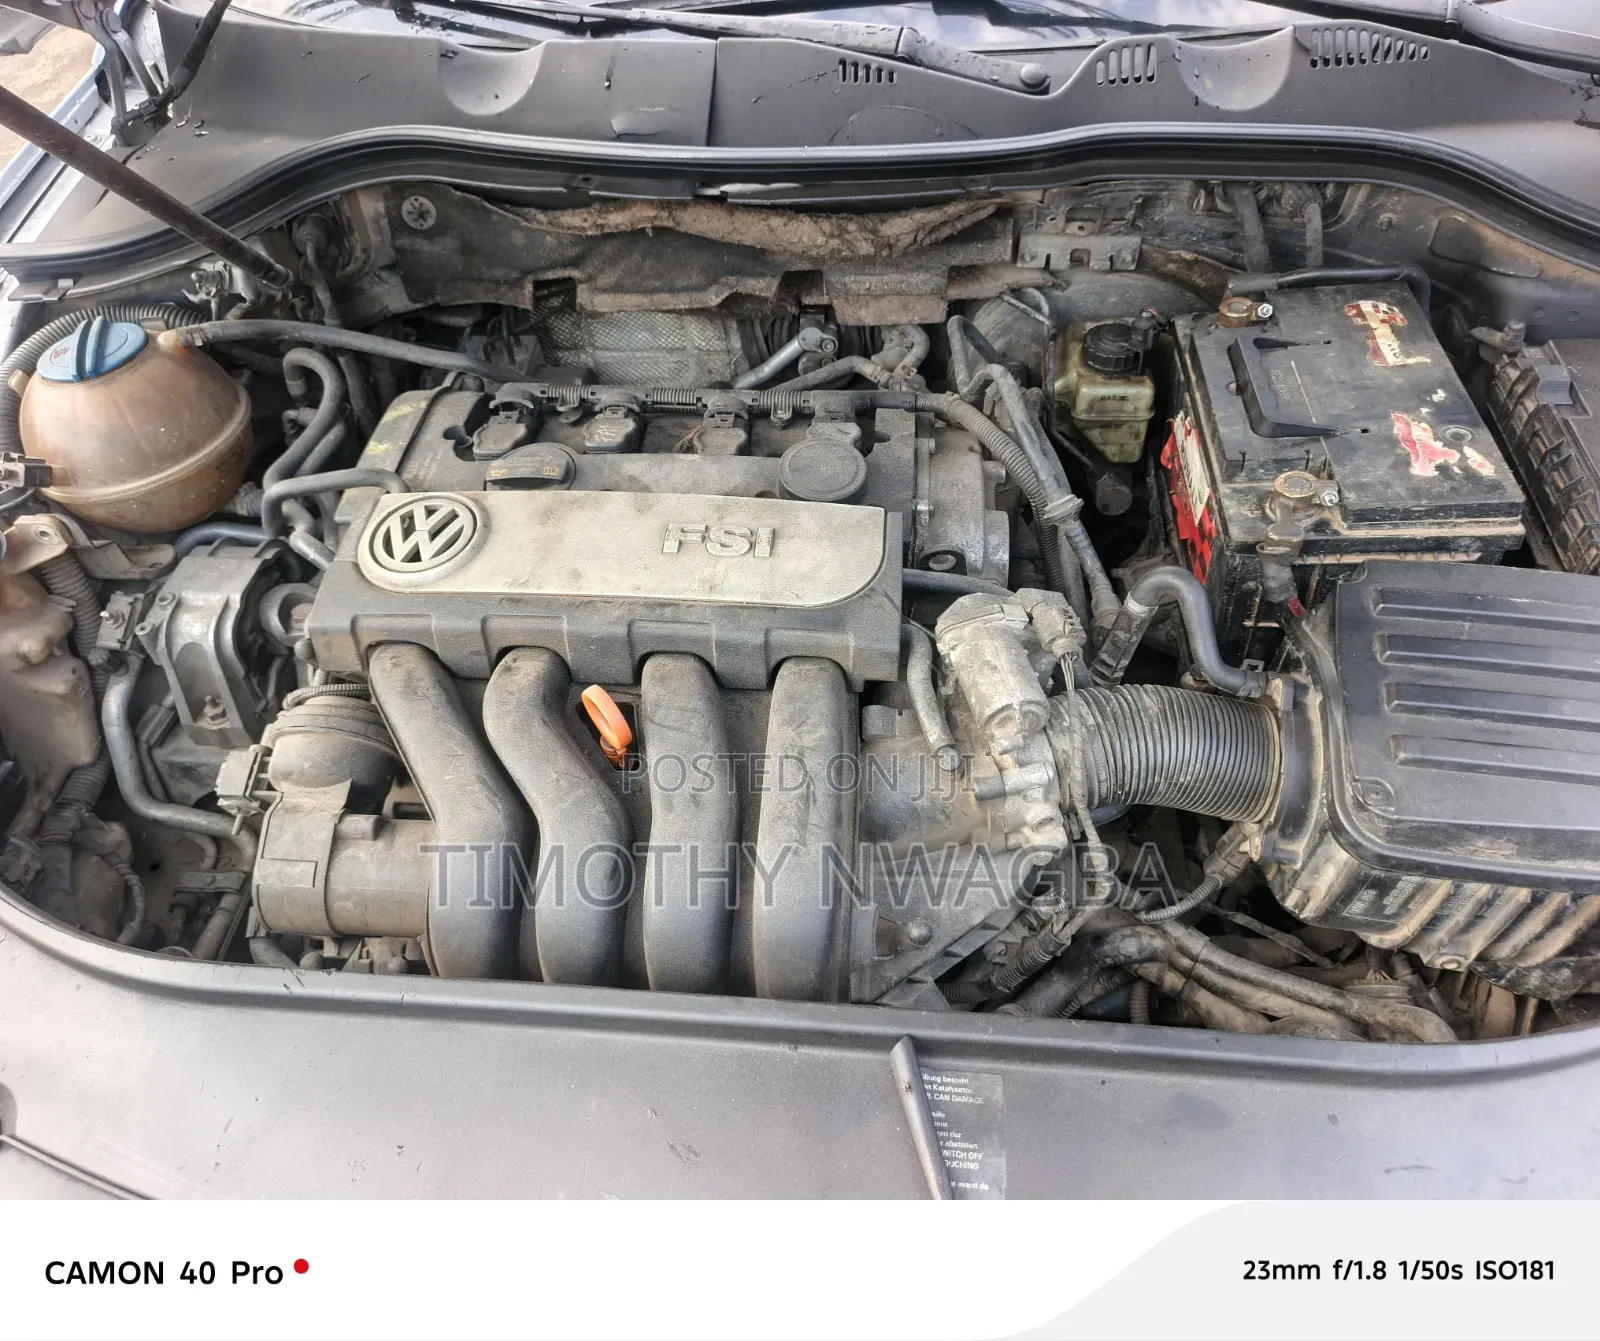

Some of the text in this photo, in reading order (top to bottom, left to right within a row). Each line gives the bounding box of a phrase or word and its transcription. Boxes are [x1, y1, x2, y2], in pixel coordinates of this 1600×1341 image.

[376, 500, 470, 568] VW
[662, 524, 776, 558] FSI
[942, 1075, 969, 1084] besteht
[932, 1083, 974, 1094] Katalysator.
[933, 1093, 950, 1102] CAN
[951, 1095, 985, 1104] DAMAGE
[968, 1151, 984, 1160] OFF
